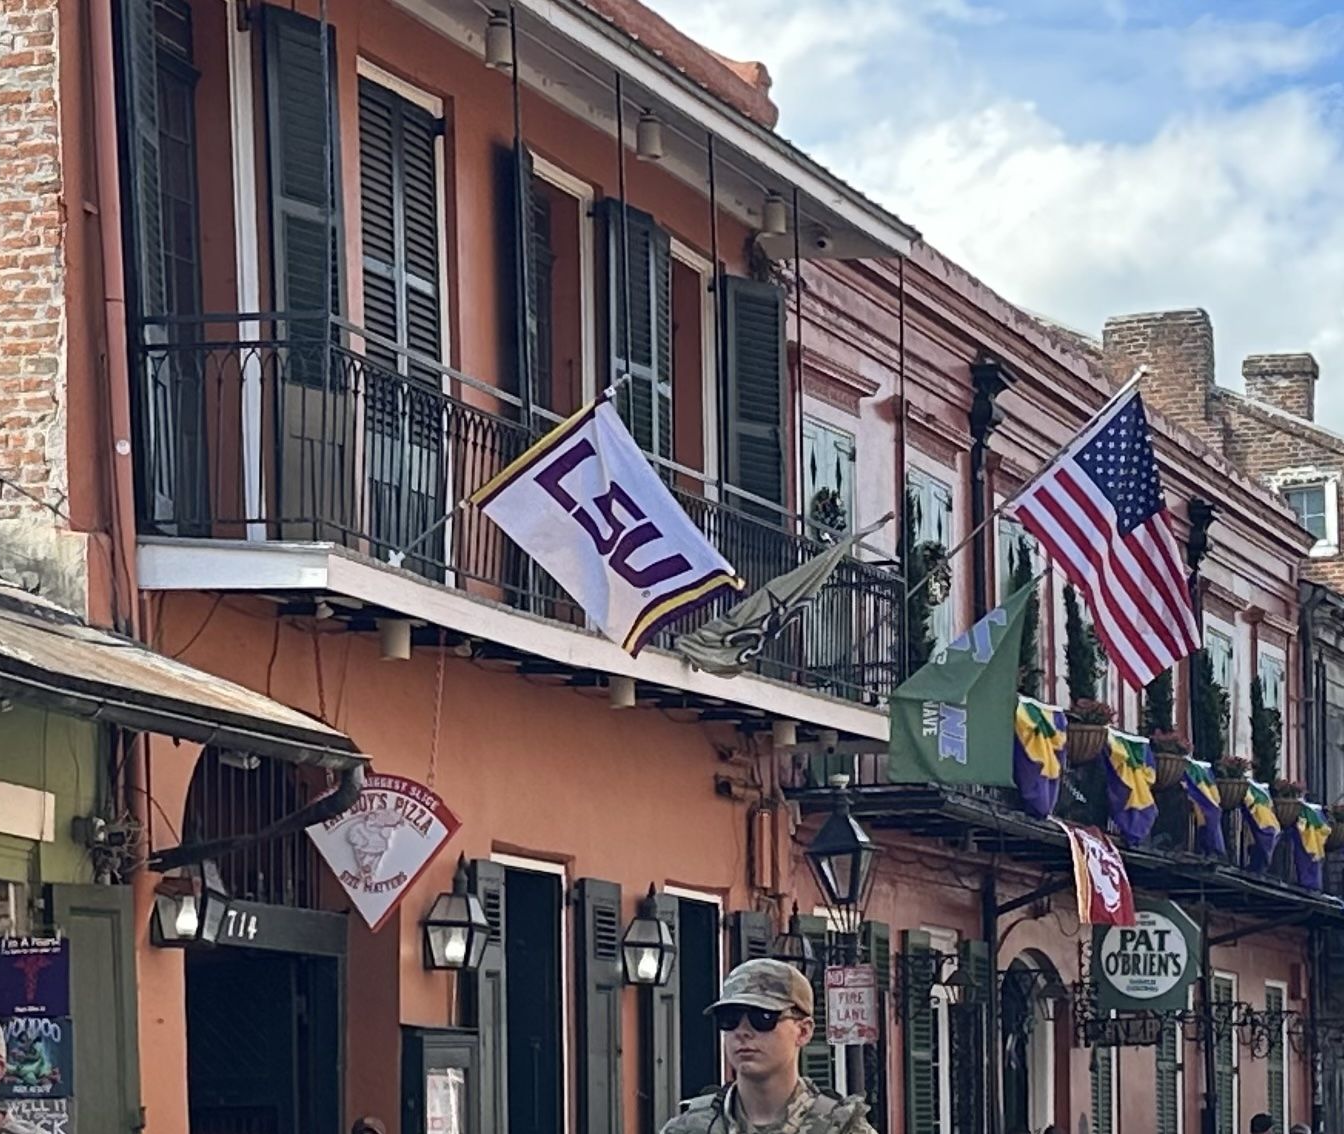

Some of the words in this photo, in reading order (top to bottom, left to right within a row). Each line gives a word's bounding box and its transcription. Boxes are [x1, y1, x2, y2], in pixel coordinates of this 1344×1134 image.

[533, 438, 693, 589] LSU
[394, 796, 434, 835] PIZZA
[227, 909, 258, 940] 714
[1119, 929, 1172, 952] PAT
[1105, 952, 1181, 977] O'BRIEN'S
[838, 991, 865, 1005] FIRE
[836, 1008, 868, 1021] LANE
